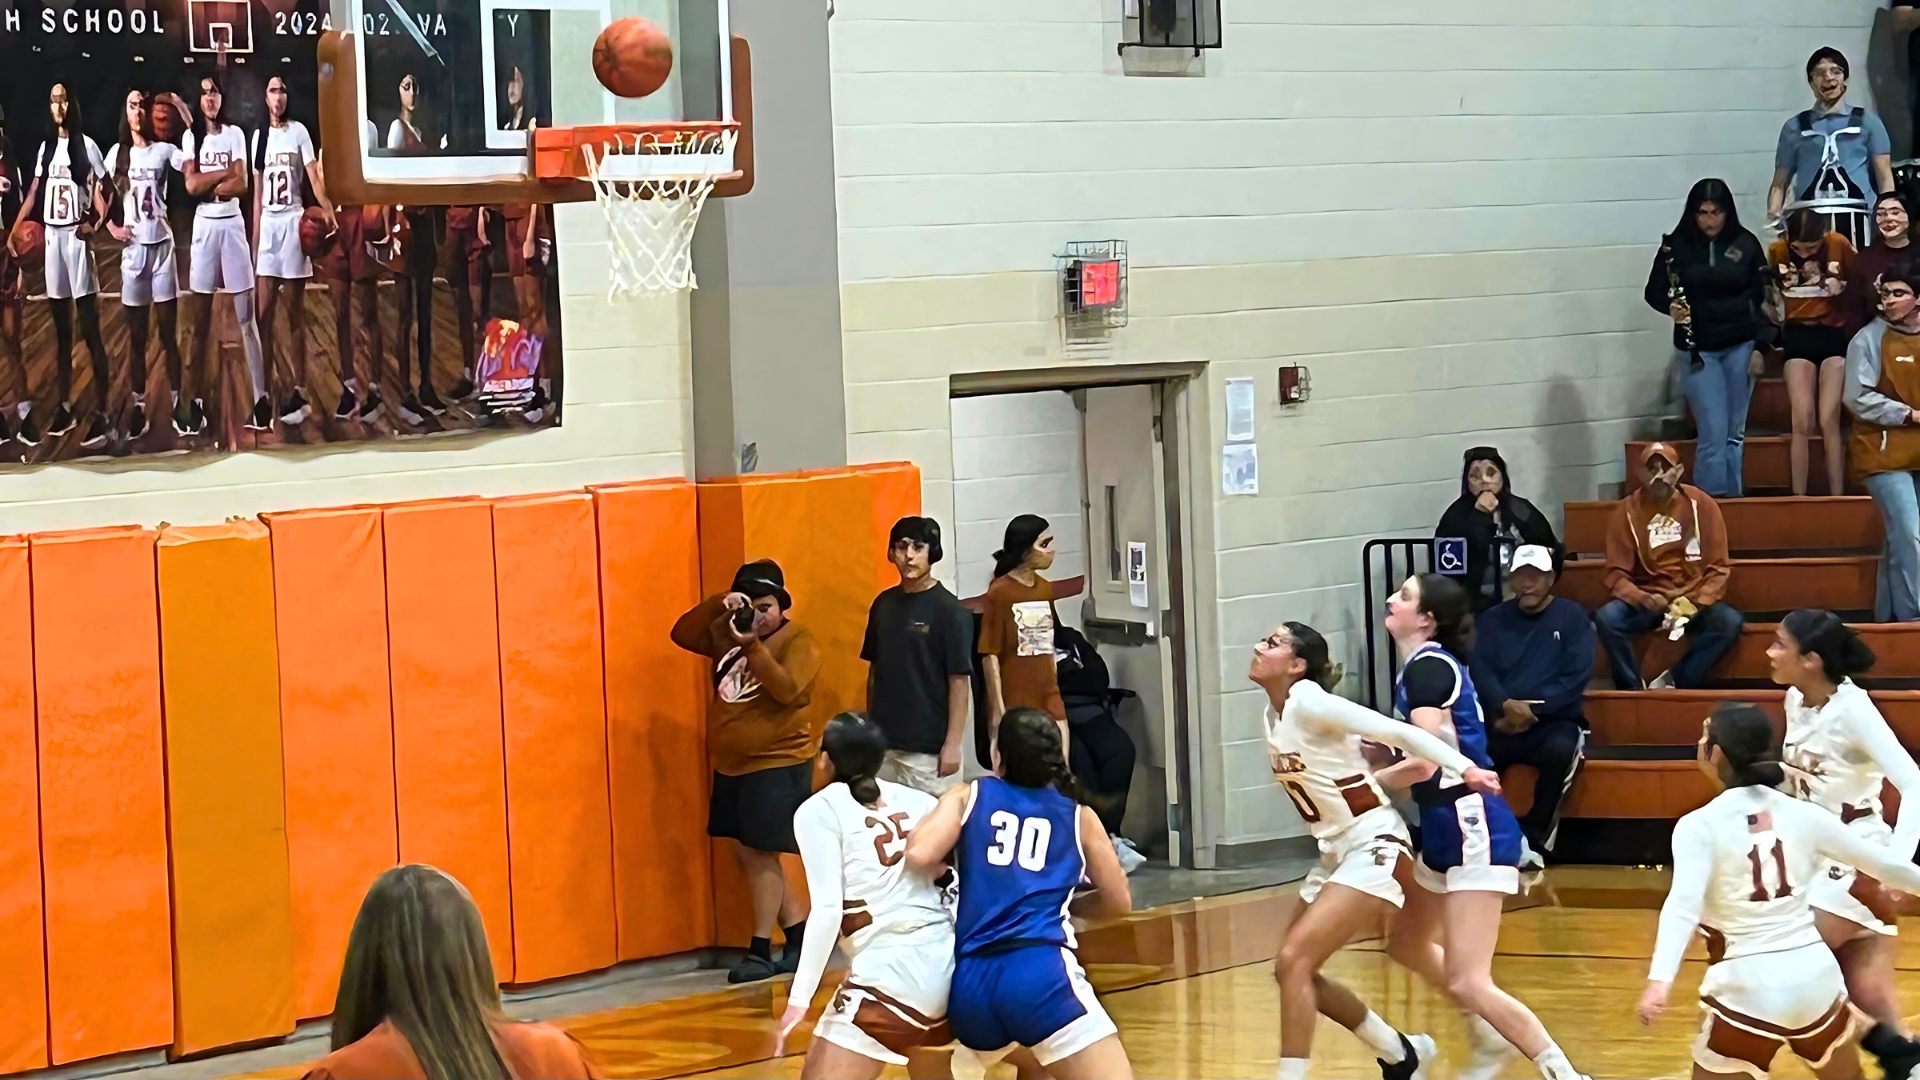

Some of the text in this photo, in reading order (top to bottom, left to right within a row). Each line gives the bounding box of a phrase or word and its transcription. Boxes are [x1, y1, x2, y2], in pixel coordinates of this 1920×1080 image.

[41, 7, 164, 34] SCHOOL
[986, 809, 1052, 872] 30
[1747, 837, 1794, 902] 11
